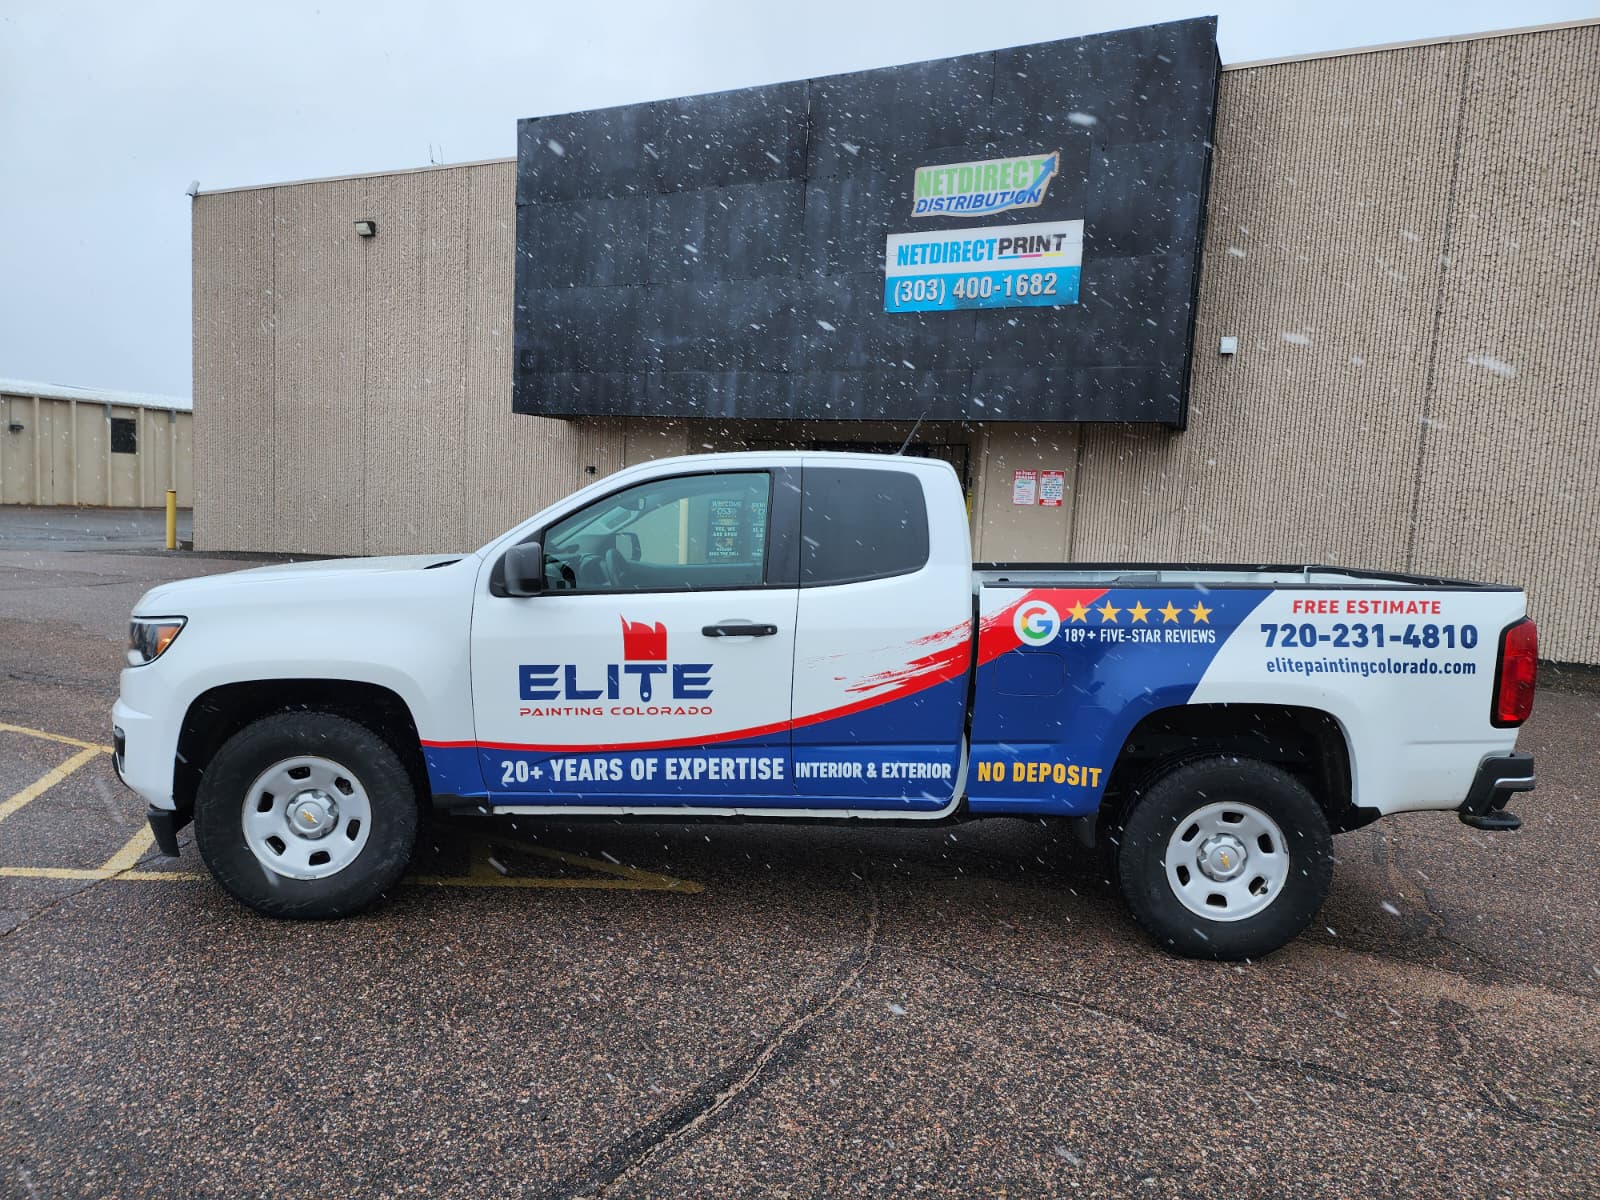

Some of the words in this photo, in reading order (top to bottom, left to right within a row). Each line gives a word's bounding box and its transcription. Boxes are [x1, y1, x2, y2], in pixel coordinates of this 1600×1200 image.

[916, 158, 1046, 198] NETDIRECT
[915, 188, 1042, 214] DISTRIBUTION
[894, 277, 946, 307] (303)
[952, 272, 1057, 300] 400-1682
[1292, 600, 1339, 614] FREE
[1346, 600, 1441, 614] ESTIMATE
[1064, 628, 1096, 643] 189+
[1100, 628, 1162, 643] FIVE-STAR
[1165, 629, 1216, 644] REVIEWS
[1260, 623, 1478, 649] 720-231-4810
[1266, 657, 1476, 677] elitepaintingcolorado.com
[518, 663, 714, 702] ELITE
[519, 706, 604, 717] PAINTING
[610, 706, 713, 716] COLORADO
[501, 760, 544, 783] 20+
[550, 758, 624, 782] YEARS
[630, 757, 658, 781] OF
[665, 757, 785, 780] EXPERTISE
[795, 762, 863, 779] INTERIOR
[866, 762, 878, 779] &
[881, 762, 951, 779] EXTERIOR
[977, 762, 1006, 782] NO
[1012, 762, 1103, 788] DEPOSIT
